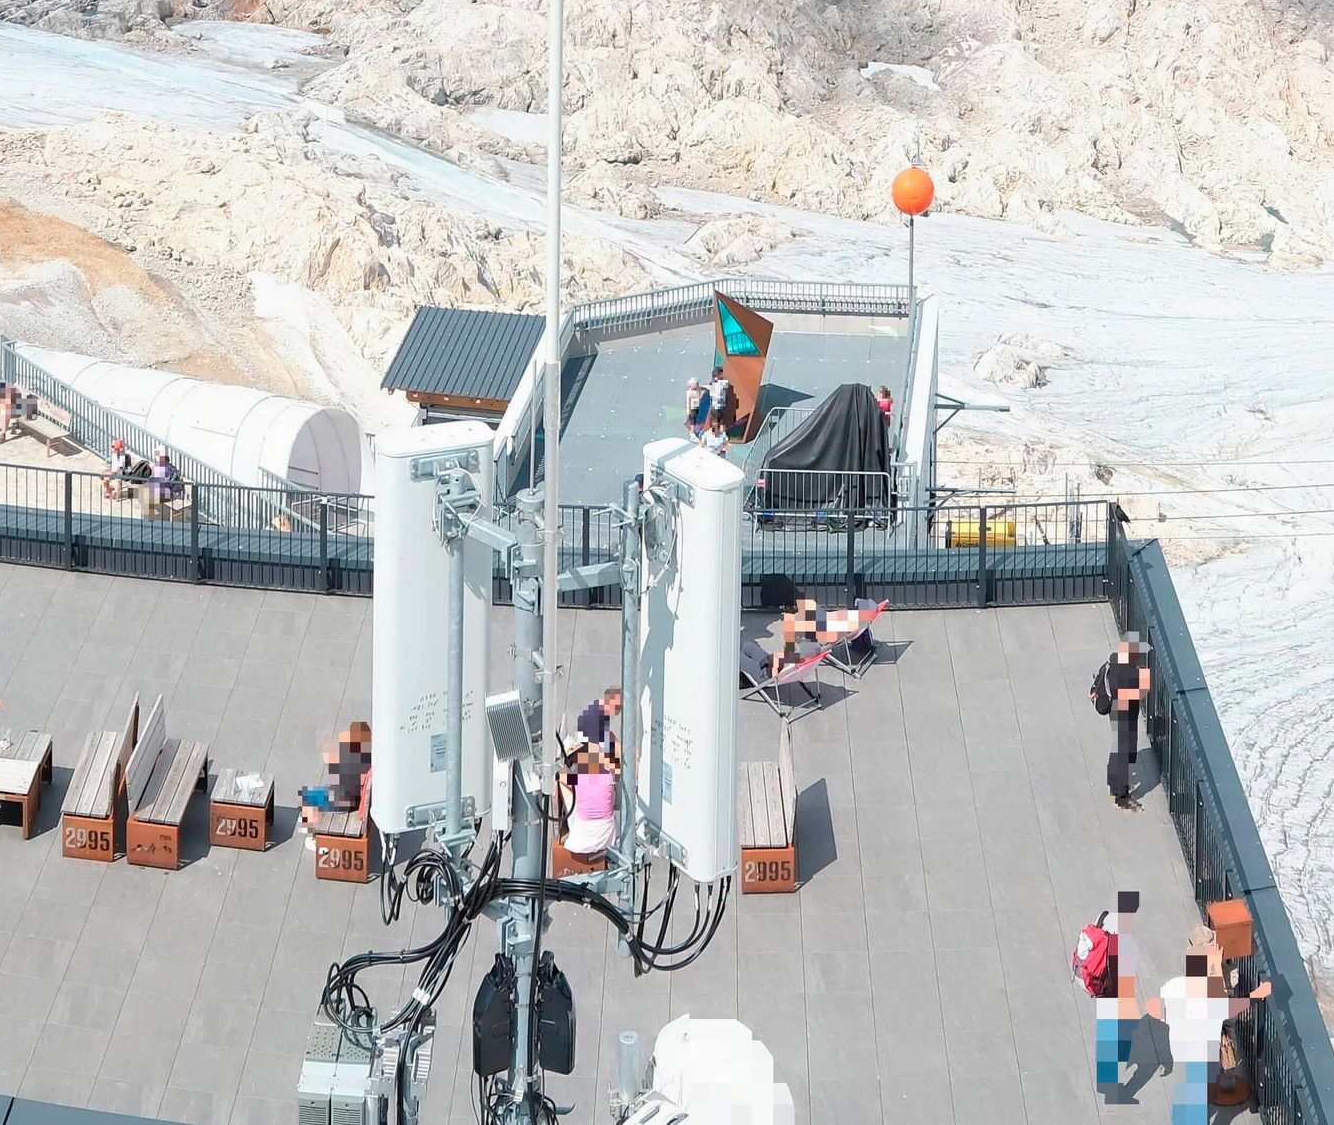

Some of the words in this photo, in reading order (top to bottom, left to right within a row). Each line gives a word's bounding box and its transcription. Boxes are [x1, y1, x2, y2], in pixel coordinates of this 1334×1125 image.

[65, 827, 110, 852] 2995
[216, 816, 259, 839] 2995
[318, 846, 364, 871] 2995
[744, 860, 791, 882] 2995
